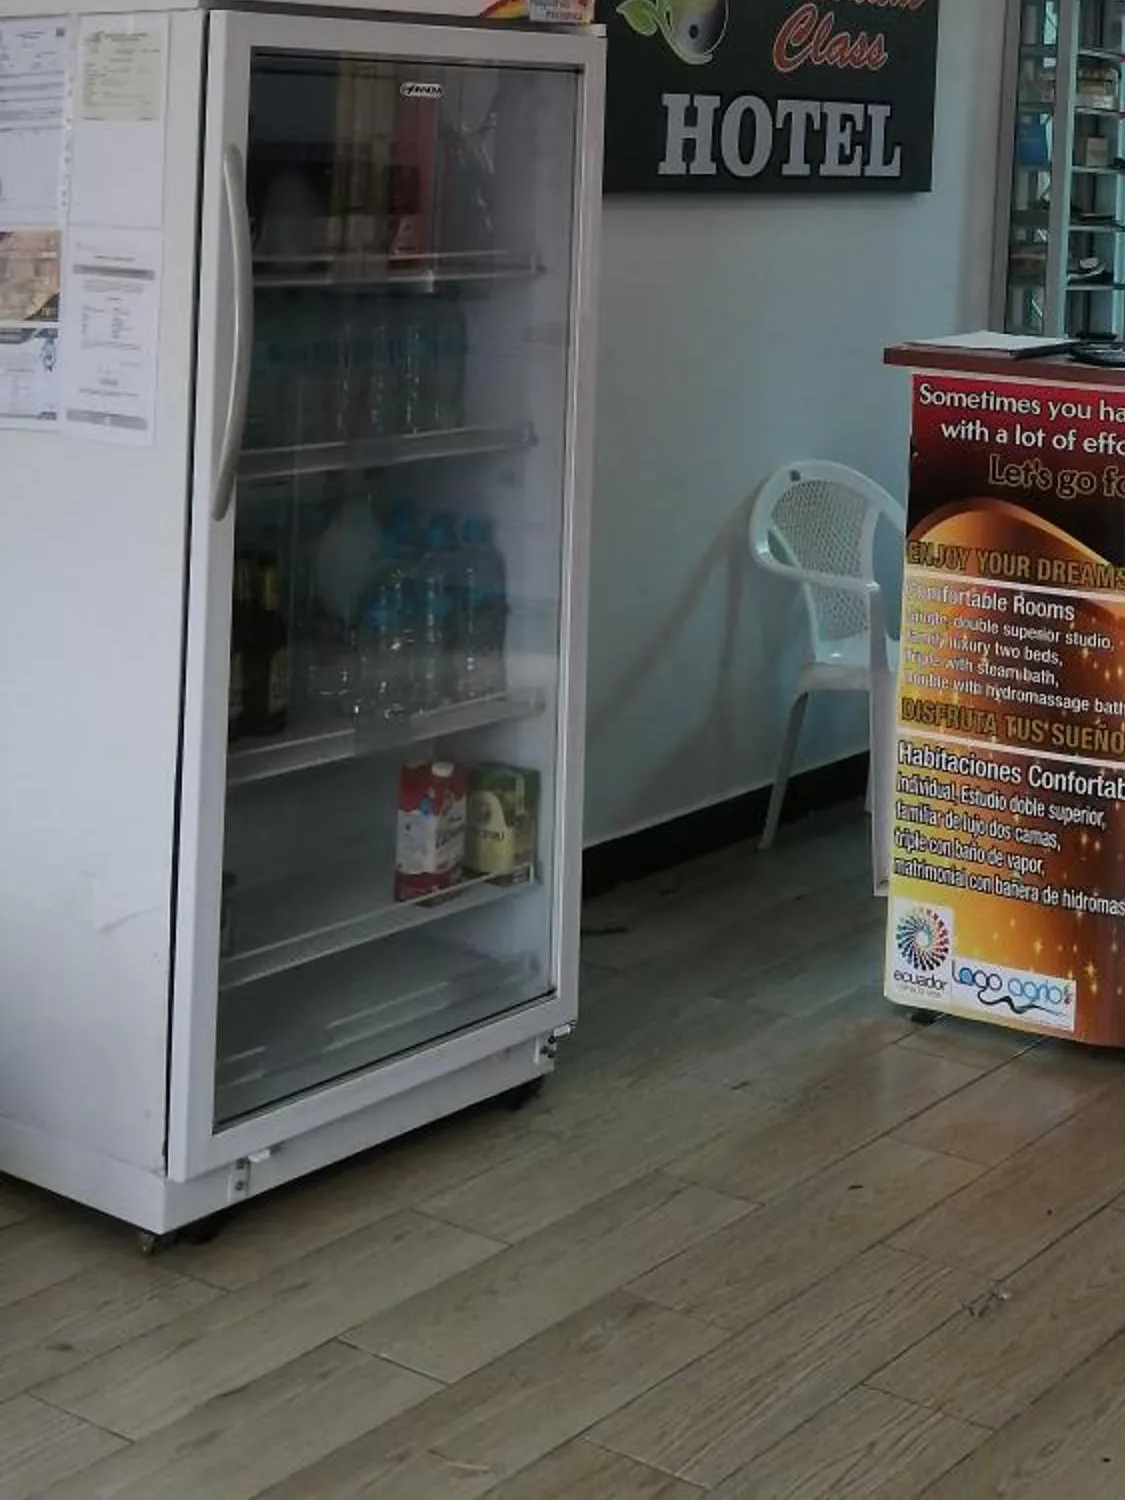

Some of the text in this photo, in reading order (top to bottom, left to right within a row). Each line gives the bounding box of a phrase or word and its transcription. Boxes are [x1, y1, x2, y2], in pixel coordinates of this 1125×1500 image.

[773, 2, 889, 73] Class
[658, 93, 902, 178] HOTEL
[919, 383, 1042, 416] Sometimes
[1048, 400, 1092, 421] you
[941, 420, 989, 443] with
[995, 431, 1009, 445] a
[1015, 424, 1046, 448] lot
[1052, 429, 1077, 451] of
[989, 452, 1052, 491] Let's
[1056, 468, 1097, 500] go
[907, 540, 969, 573] ENJOY
[975, 549, 1032, 580] YOUR
[1012, 591, 1077, 623] Rooms
[953, 615, 999, 635] double
[1003, 622, 1060, 646] superior
[948, 636, 991, 659] luxury
[994, 640, 1021, 659] two
[1025, 646, 1063, 667] beds,
[977, 659, 1021, 681] steam
[1022, 667, 1059, 688] bath,
[985, 682, 1090, 714] hydromassage
[899, 696, 998, 737] DISFRUTA
[1005, 713, 1046, 744] TUS
[896, 740, 1022, 784] Habitaciones
[960, 784, 1007, 811] Estudio
[1009, 794, 1045, 818] doble
[1048, 803, 1106, 831] superior,
[944, 808, 961, 829] de
[989, 818, 1012, 841] dos
[1014, 826, 1061, 853] camas,
[1006, 850, 1045, 878] vapor,
[968, 873, 993, 894] con
[1042, 886, 1060, 906] de
[893, 969, 949, 992] ecuador
